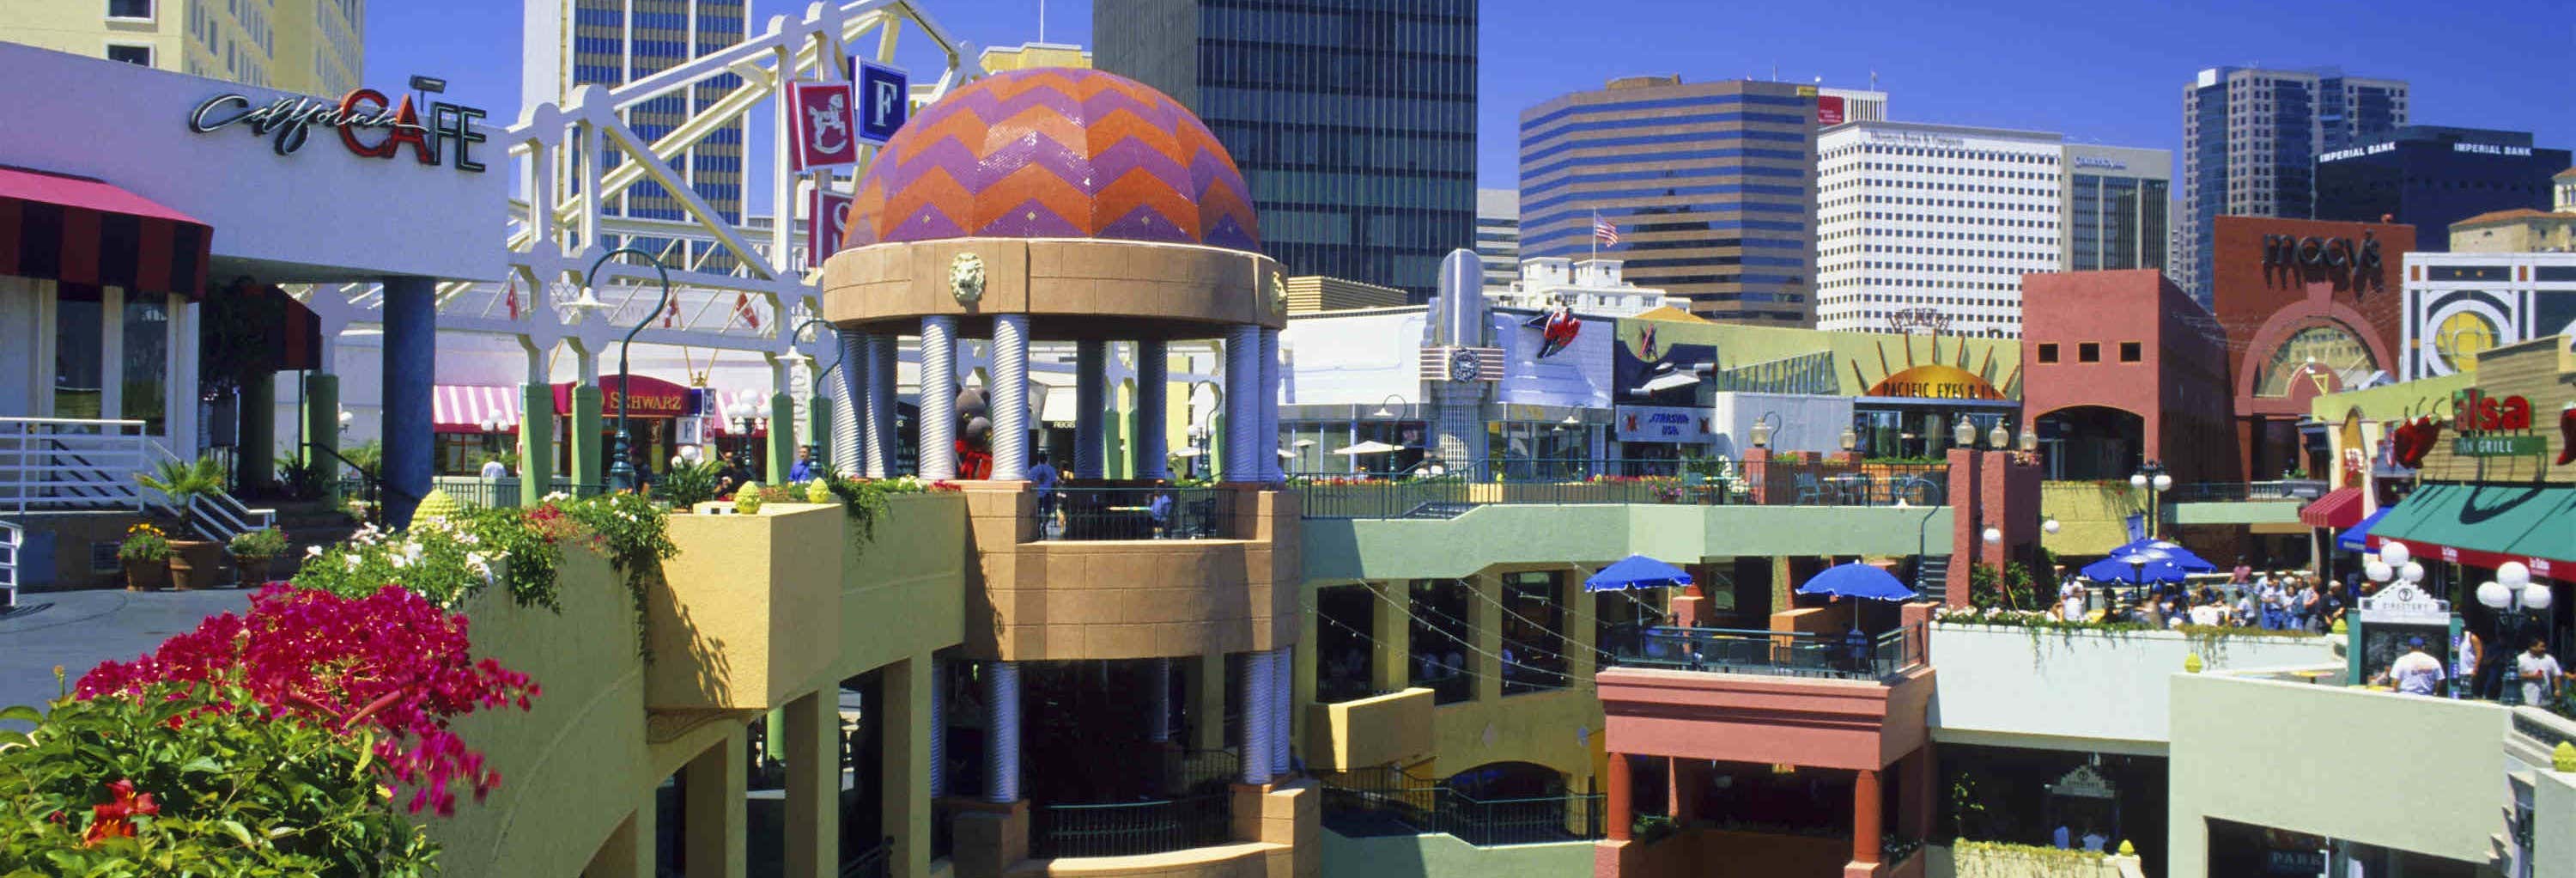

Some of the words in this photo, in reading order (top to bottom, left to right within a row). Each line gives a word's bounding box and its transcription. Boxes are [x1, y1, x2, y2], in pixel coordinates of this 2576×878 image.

[872, 80, 898, 127] F
[189, 93, 429, 155] California
[2319, 147, 2366, 163] IMPERIAL
[2367, 141, 2396, 155] BANK
[2453, 142, 2502, 155] IMPERIAL
[2503, 143, 2532, 156] BANK
[1882, 382, 1930, 398] PACIFIC
[1936, 383, 1965, 399] EYES
[611, 392, 682, 411] SHWARZ
[2477, 438, 2514, 454] GRILL
